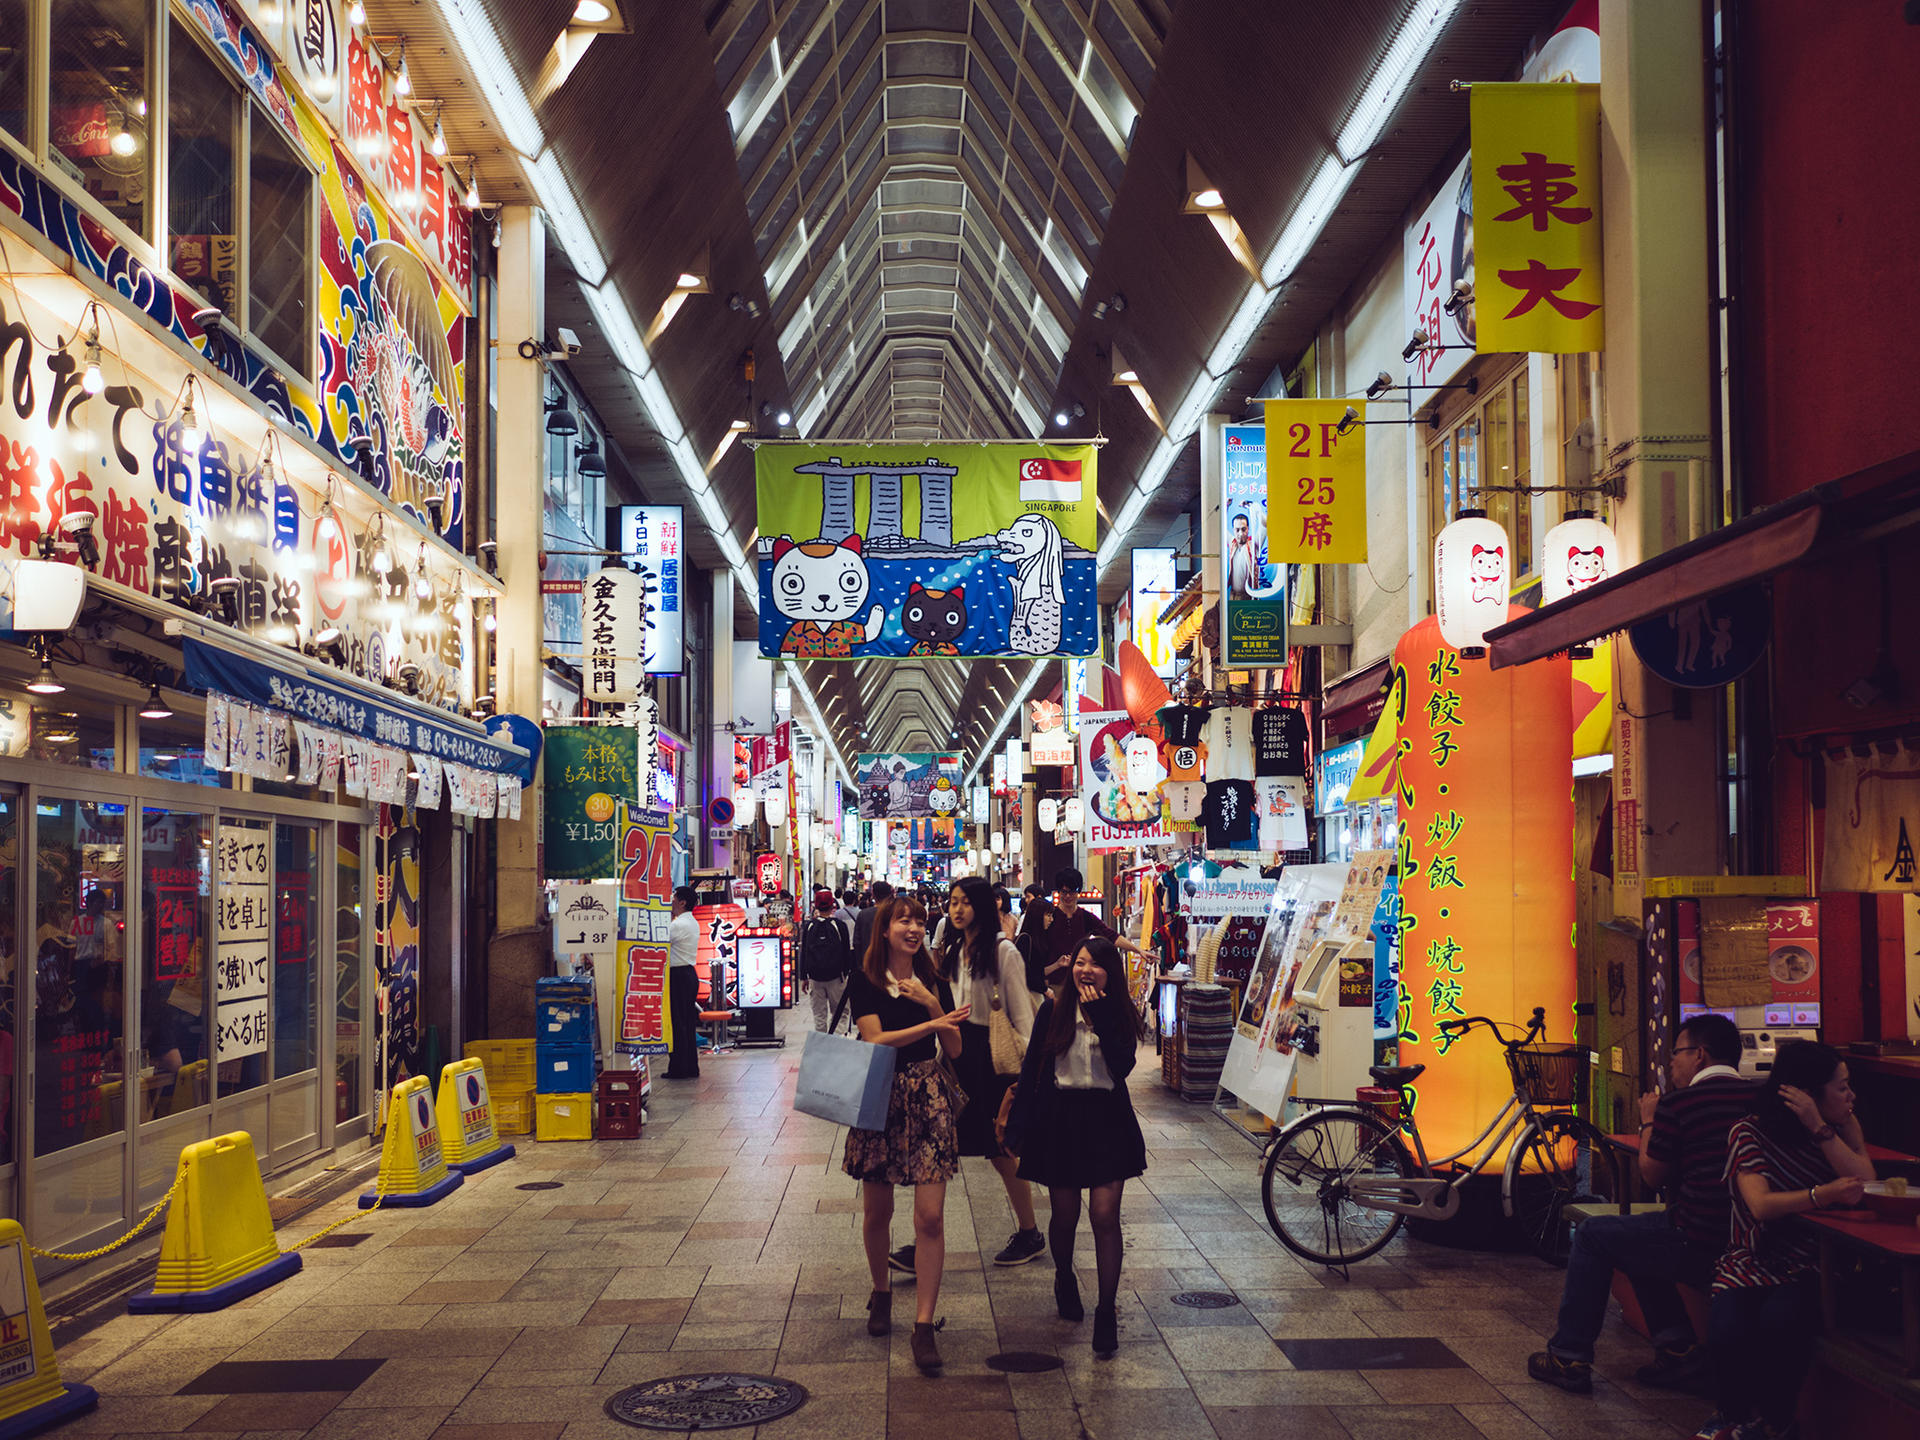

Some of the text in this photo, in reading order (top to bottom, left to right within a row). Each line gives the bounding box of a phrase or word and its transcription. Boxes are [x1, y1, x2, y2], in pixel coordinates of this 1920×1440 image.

[1492, 152, 1602, 320] 東大
[1288, 422, 1338, 458] 2F
[1297, 477, 1335, 505] 25
[1024, 502, 1076, 512] SINGAPORE
[634, 511, 649, 555] 千日前
[1298, 512, 1333, 551] 席
[661, 522, 678, 612] 新鮮居酒屋
[592, 576, 618, 693] 金久右衛門
[581, 745, 618, 764] 本格
[1178, 749, 1193, 767] 悟
[1263, 751, 1289, 759] おおきに
[563, 765, 632, 783] もみほぐし
[591, 797, 609, 811] 30
[629, 810, 667, 827] Welcome!
[710, 829, 734, 839] 自動車
[1092, 823, 1171, 842] FUJIYAMA
[571, 911, 605, 922] tiara
[592, 933, 609, 944] 3F
[749, 941, 767, 1004] ラーメン
[1340, 983, 1372, 995] 水餃子
